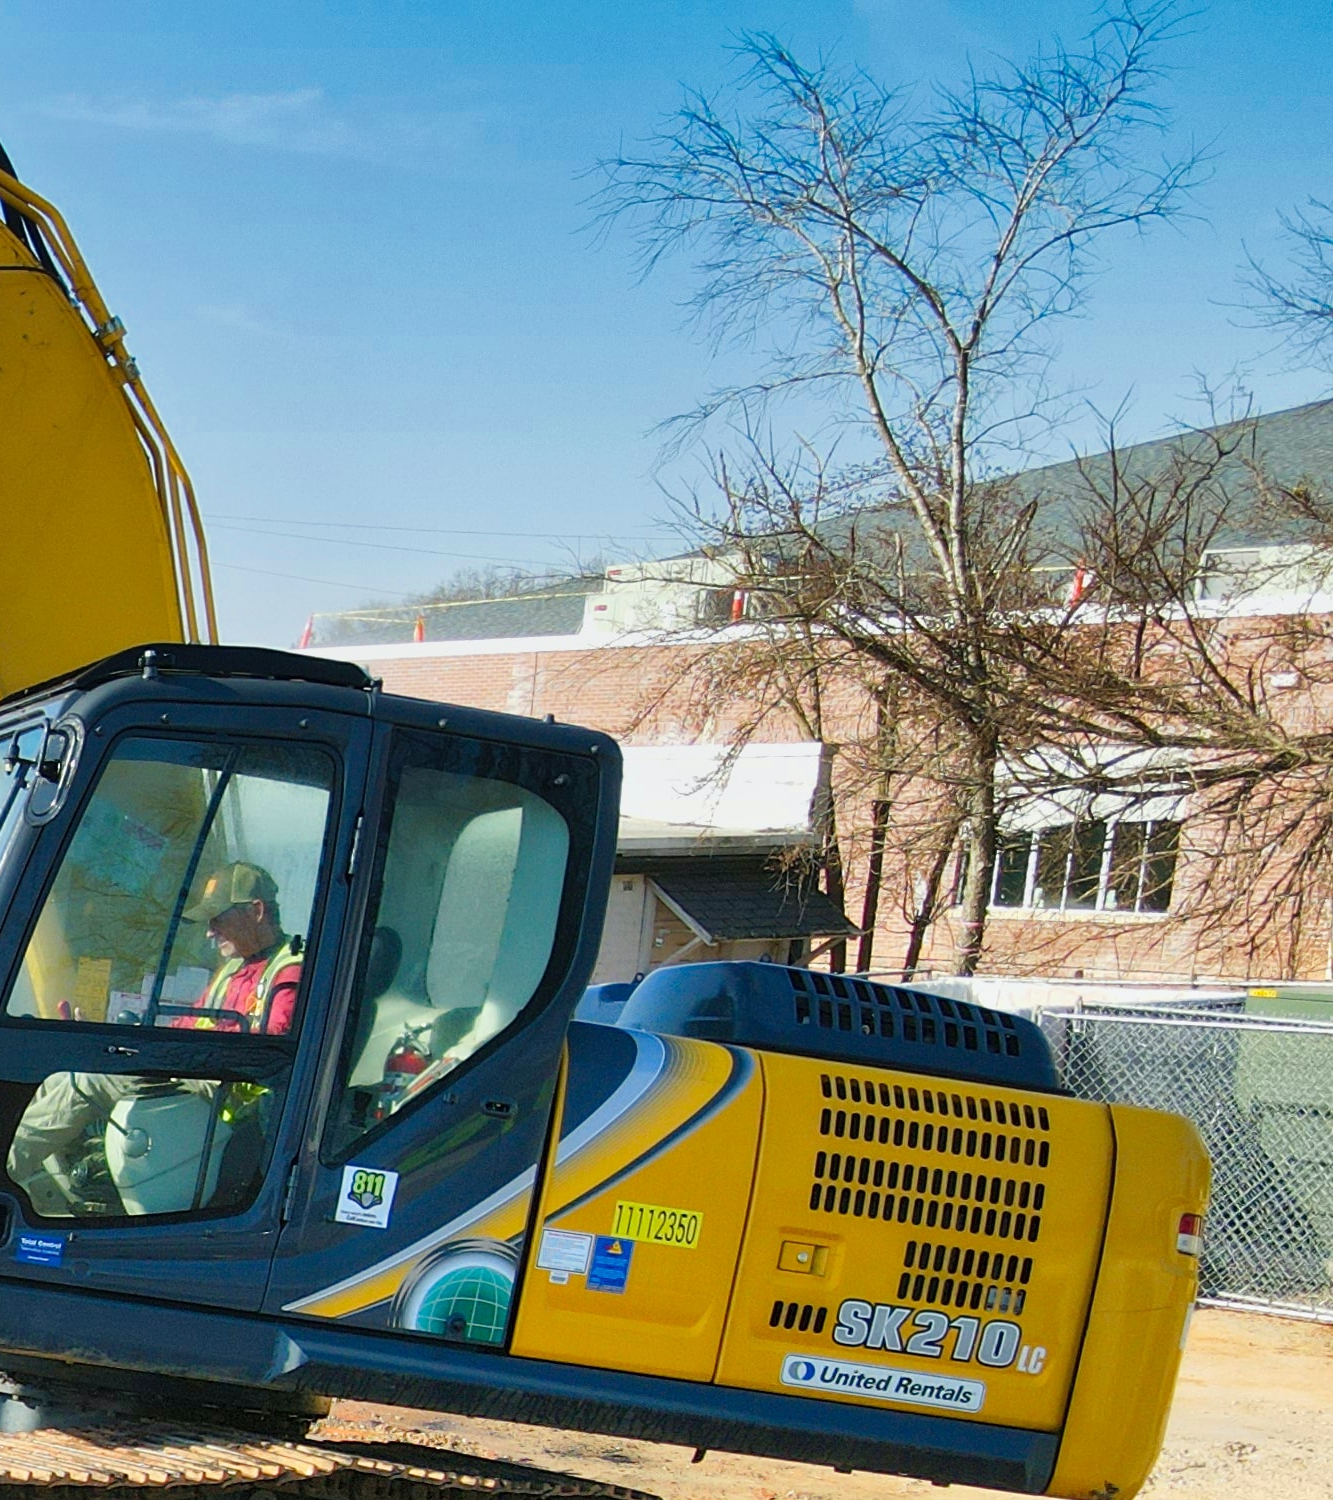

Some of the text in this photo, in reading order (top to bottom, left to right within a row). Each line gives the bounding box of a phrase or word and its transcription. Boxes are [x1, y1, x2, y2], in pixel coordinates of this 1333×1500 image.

[352, 1169, 385, 1198] 811
[615, 1204, 698, 1245] 11112350
[833, 1299, 1022, 1368] SK210
[820, 1365, 973, 1404] United Rentals
